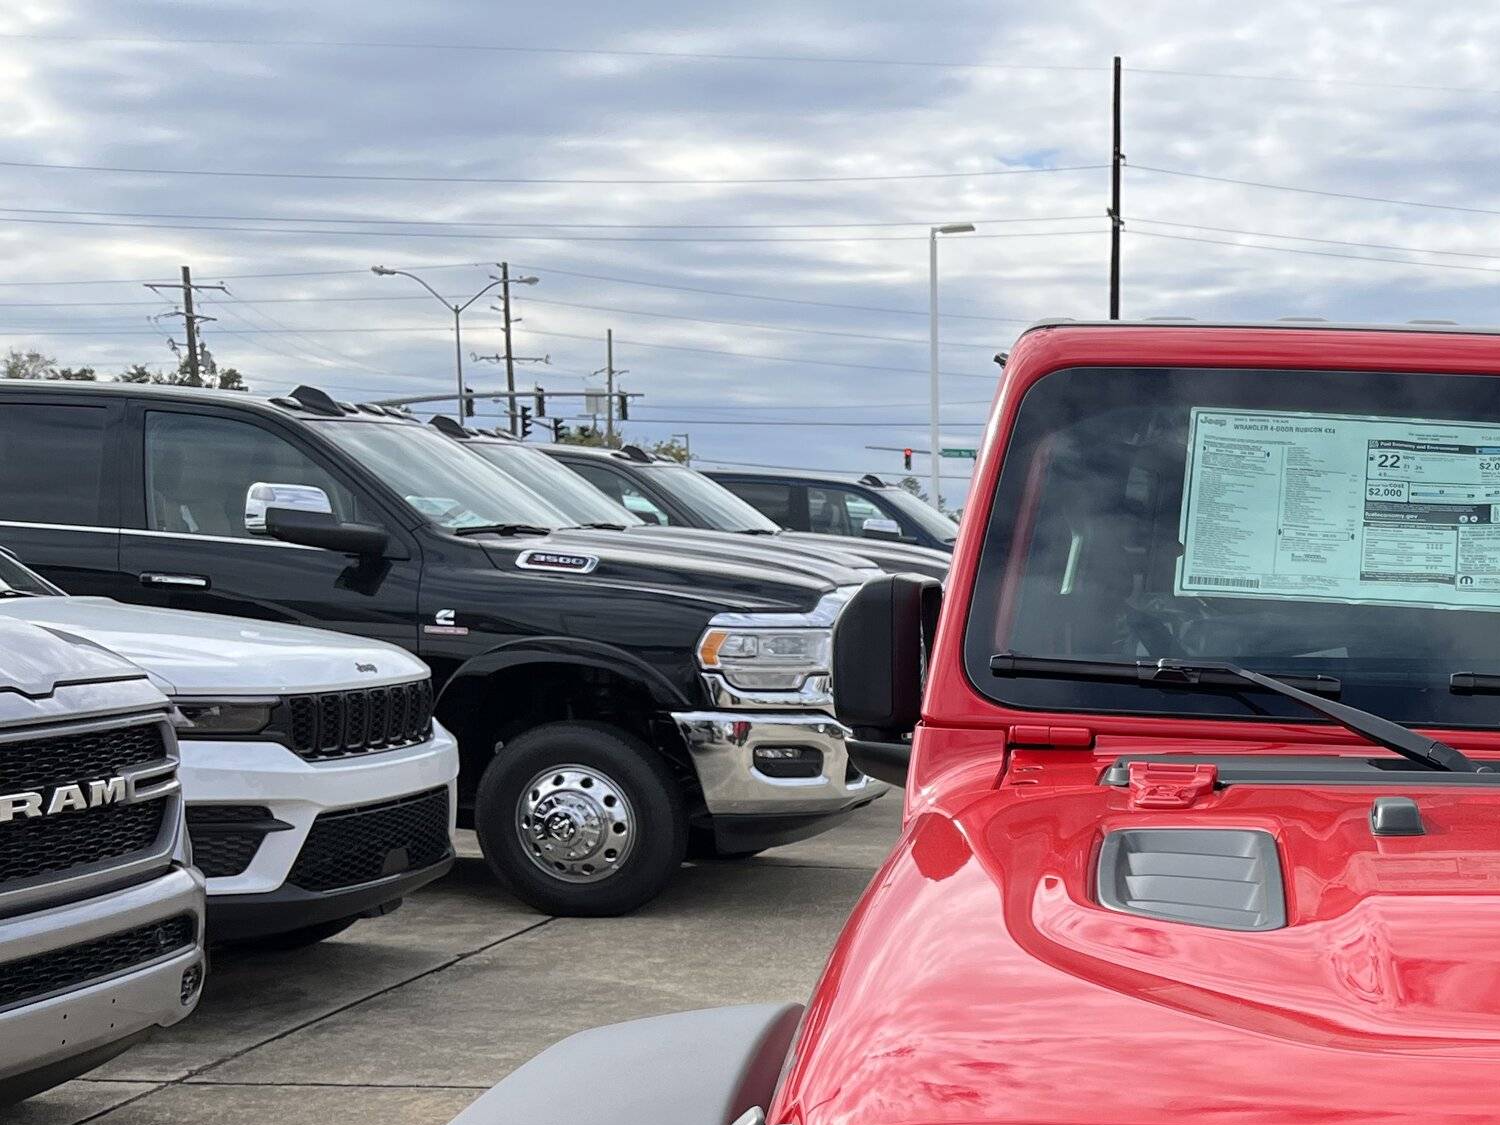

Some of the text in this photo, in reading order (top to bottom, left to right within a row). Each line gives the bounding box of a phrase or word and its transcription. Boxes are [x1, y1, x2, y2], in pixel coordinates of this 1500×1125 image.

[1378, 454, 1401, 469] 22
[1368, 487, 1402, 497] $2,000
[533, 554, 585, 565] 3500
[0, 776, 126, 822] RAM
